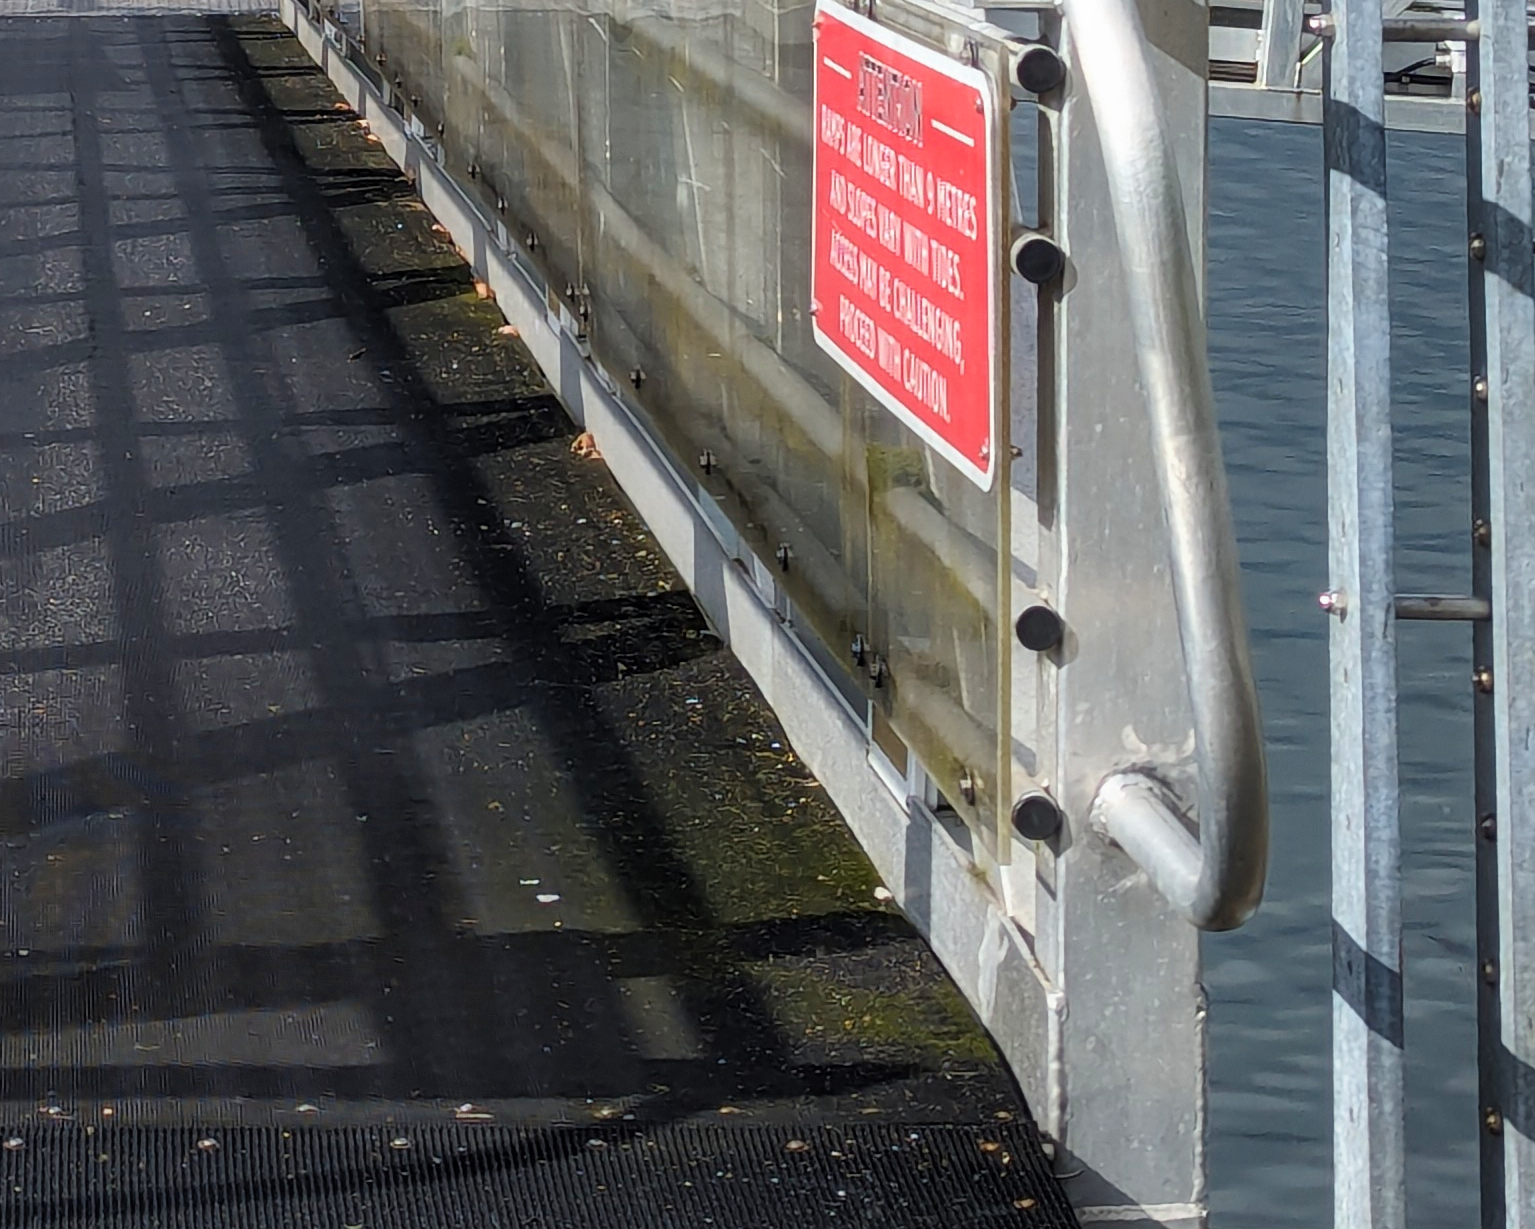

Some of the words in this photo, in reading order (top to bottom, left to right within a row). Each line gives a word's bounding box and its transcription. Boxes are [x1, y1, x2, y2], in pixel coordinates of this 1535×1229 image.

[821, 103, 846, 156] RAMPS
[846, 122, 862, 168] ARE
[864, 133, 897, 192] LONGER
[898, 154, 924, 209] THAN
[926, 171, 935, 215] 9
[936, 177, 978, 241] METRES
[830, 169, 846, 215] AND
[847, 182, 877, 239] SLOPES
[878, 203, 901, 257] VARY
[903, 220, 929, 277] WITH
[930, 239, 965, 301] TIDES.
[830, 229, 858, 285] ACCESS
[859, 250, 878, 301] MAY
[879, 265, 892, 313] BE
[839, 293, 876, 360] PROCEED
[877, 325, 902, 384] WITH
[903, 347, 951, 424] CAUTION.
